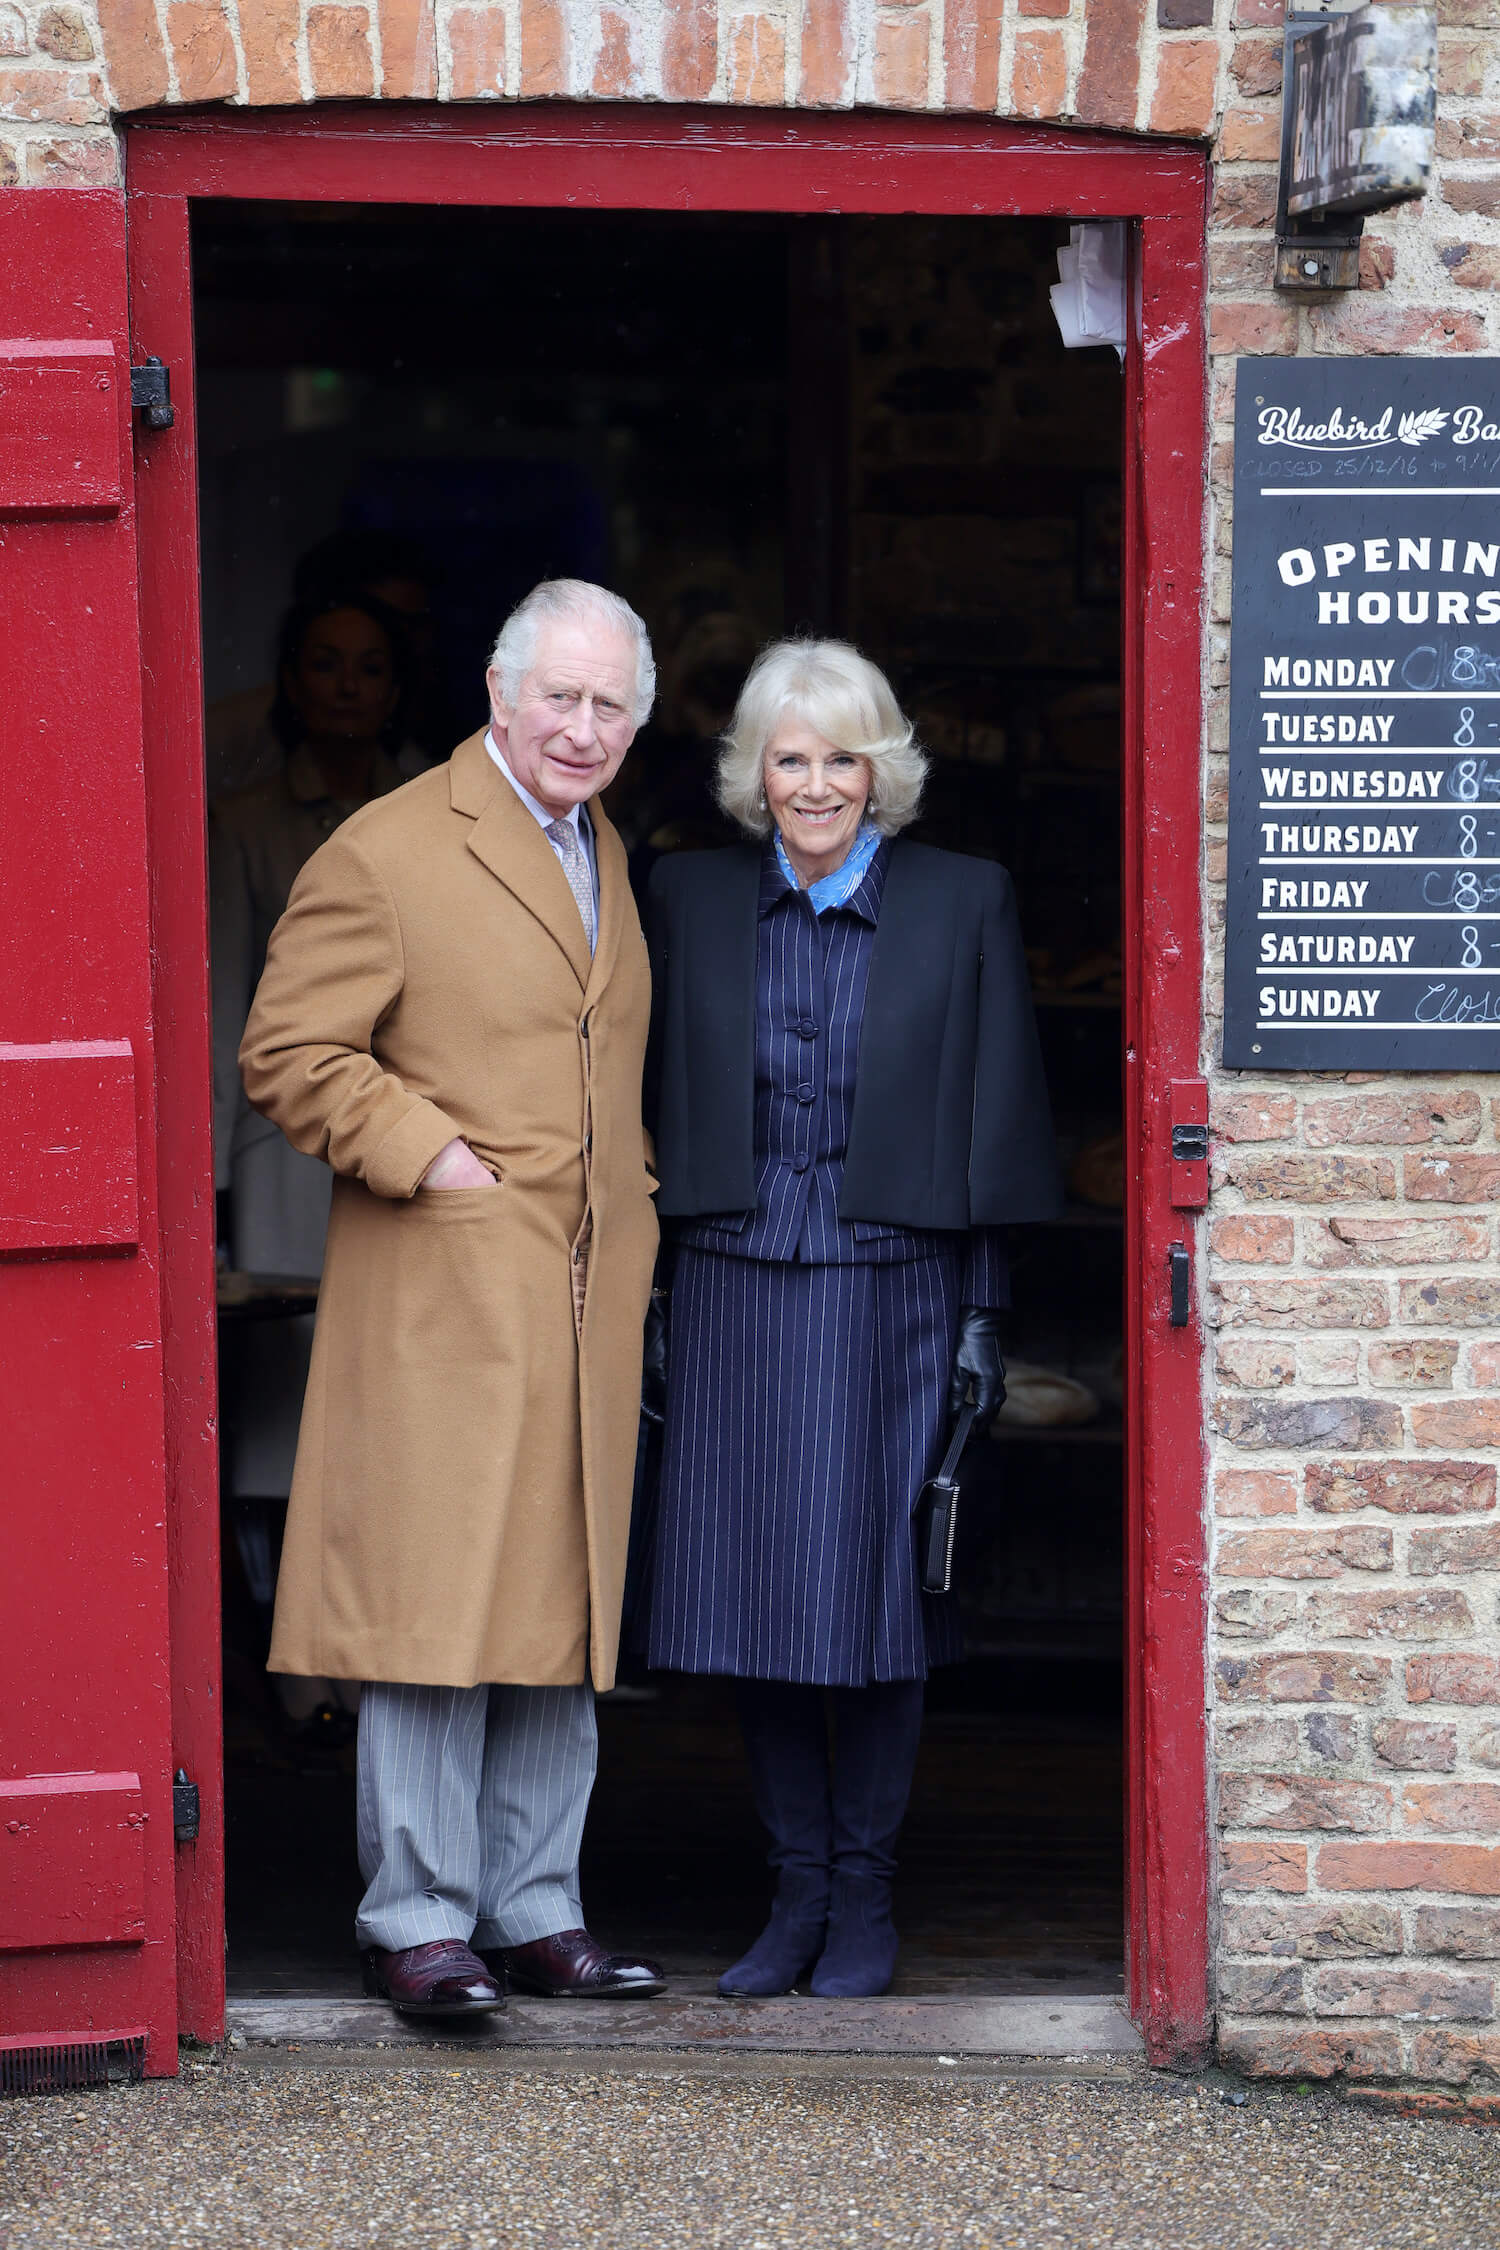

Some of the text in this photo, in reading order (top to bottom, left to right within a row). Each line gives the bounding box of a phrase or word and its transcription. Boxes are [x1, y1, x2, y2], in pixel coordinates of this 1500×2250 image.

[1257, 406, 1398, 451] Bluebird
[1239, 460, 1322, 478] CLOSED
[1335, 455, 1417, 477] 25/12/16
[1277, 537, 1500, 587] OPENIN
[1318, 591, 1500, 625] HOURS
[1263, 656, 1396, 687] MONDAY
[1262, 712, 1395, 743] TUESDAY
[1453, 706, 1475, 747] 8
[1260, 767, 1444, 798] WEDNESDAY
[1260, 823, 1420, 852] THURSDAY
[1459, 814, 1477, 858] 8
[1261, 878, 1369, 908] FRIDAY
[1259, 933, 1416, 963] SATURDAY
[1461, 925, 1482, 968] 8
[1258, 987, 1381, 1017] SUNDAY
